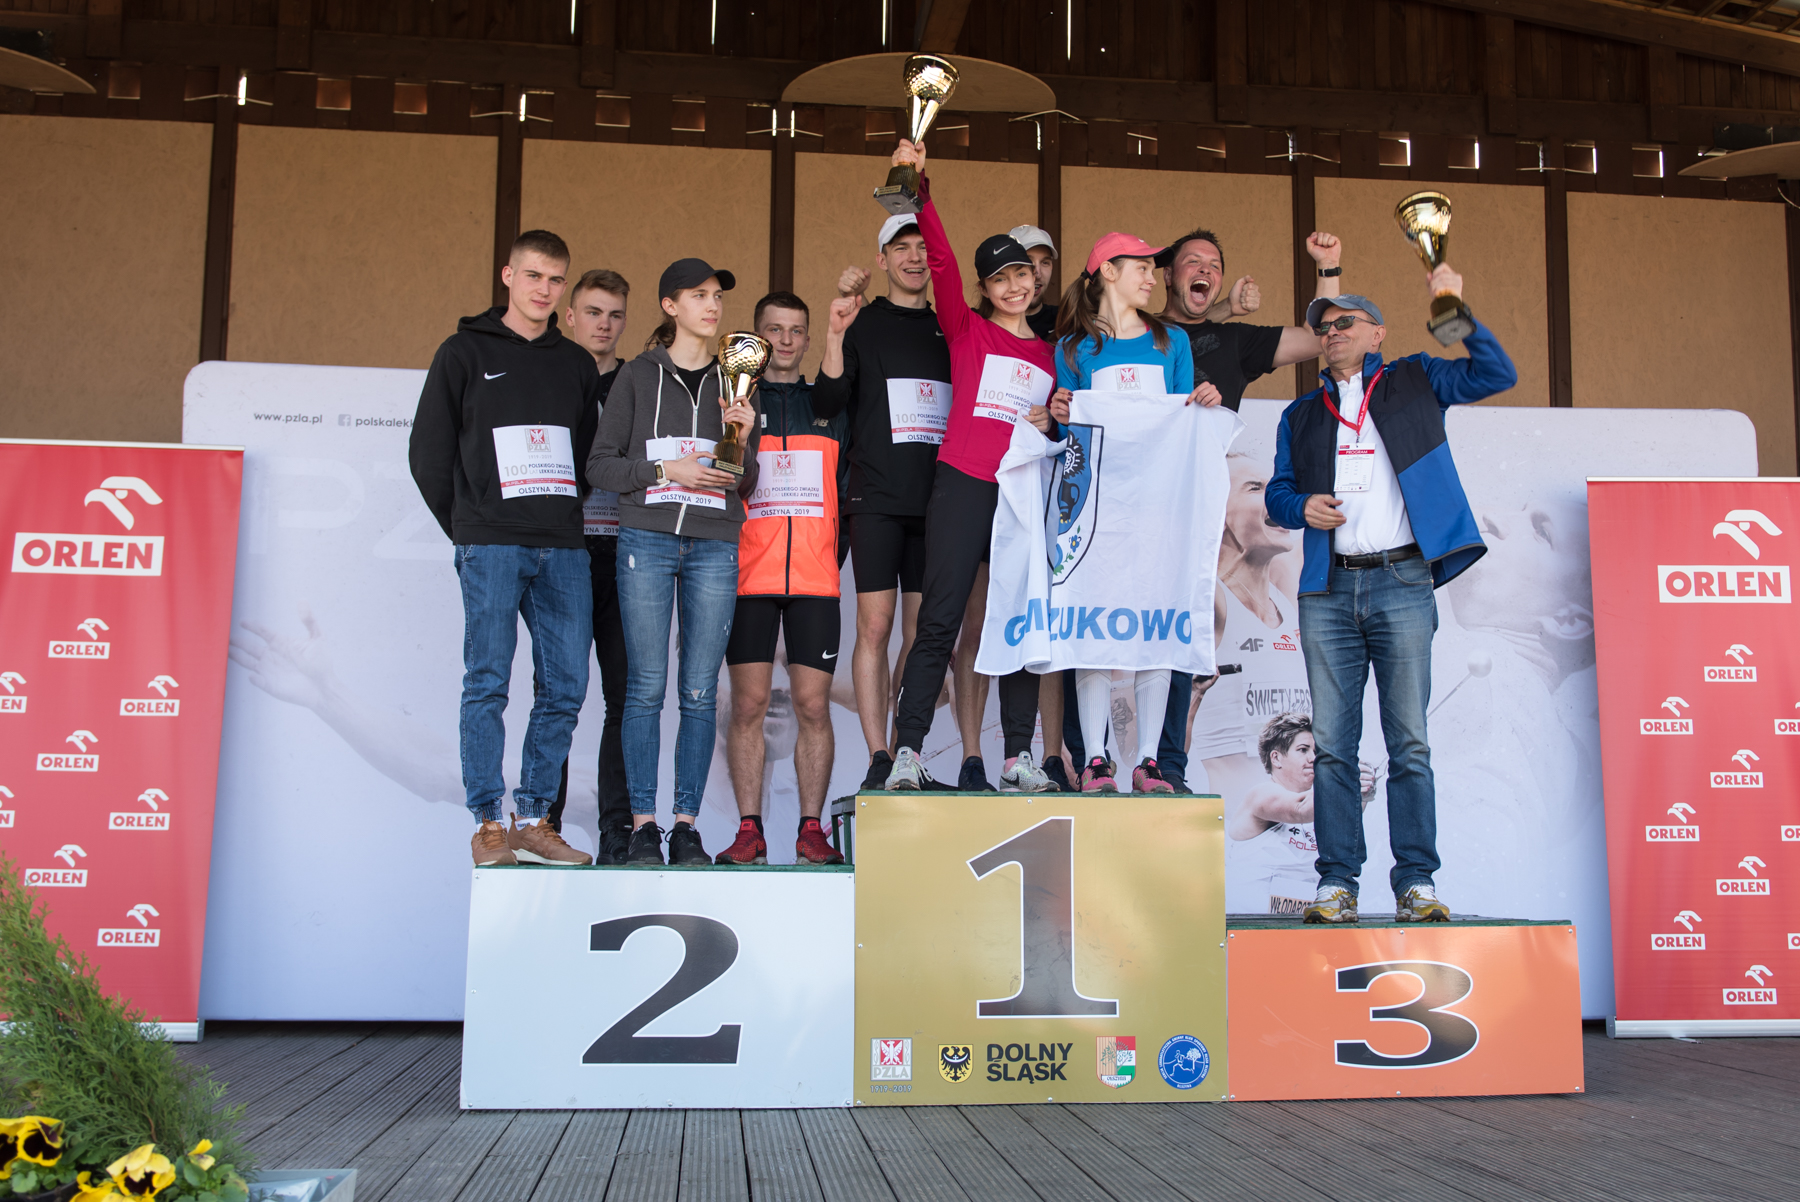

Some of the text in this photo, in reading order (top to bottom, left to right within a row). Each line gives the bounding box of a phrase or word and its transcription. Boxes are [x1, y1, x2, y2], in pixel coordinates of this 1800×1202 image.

[983, 389, 1004, 401] 100
[253, 413, 323, 425] www.pzla.pl
[895, 413, 917, 424] 100
[907, 434, 935, 442] OLSZYNA
[504, 464, 528, 477] 100
[518, 486, 551, 495] OLSZYNA
[660, 494, 712, 505] OLSZYNA 2019
[761, 509, 791, 517] OLSZYNA
[21, 539, 154, 569] ORLEN
[1665, 570, 1782, 597] ORLEN
[52, 643, 106, 656] ORLEN
[1707, 669, 1753, 680] ORLEN
[123, 702, 176, 713] ORLEN
[1643, 721, 1690, 732] ORLEN
[40, 756, 95, 769] ORLEN
[1713, 774, 1760, 786] ORLEN
[113, 815, 166, 827] ORLEN
[1649, 828, 1696, 840] ORLEN
[28, 872, 84, 884] ORLEN
[1719, 881, 1766, 893] ORLEN
[966, 816, 1119, 1019] 1
[101, 931, 156, 944] ORLEN
[1654, 936, 1702, 948] ORLEN
[581, 914, 744, 1066] 2
[1726, 991, 1773, 1003] ORLEN
[1335, 960, 1479, 1069] 3
[986, 1043, 1073, 1062] DOLNY
[873, 1067, 909, 1079] PZLA
[986, 1060, 1067, 1084] ŚLĄSK
[870, 1085, 912, 1093] 1919-2019
